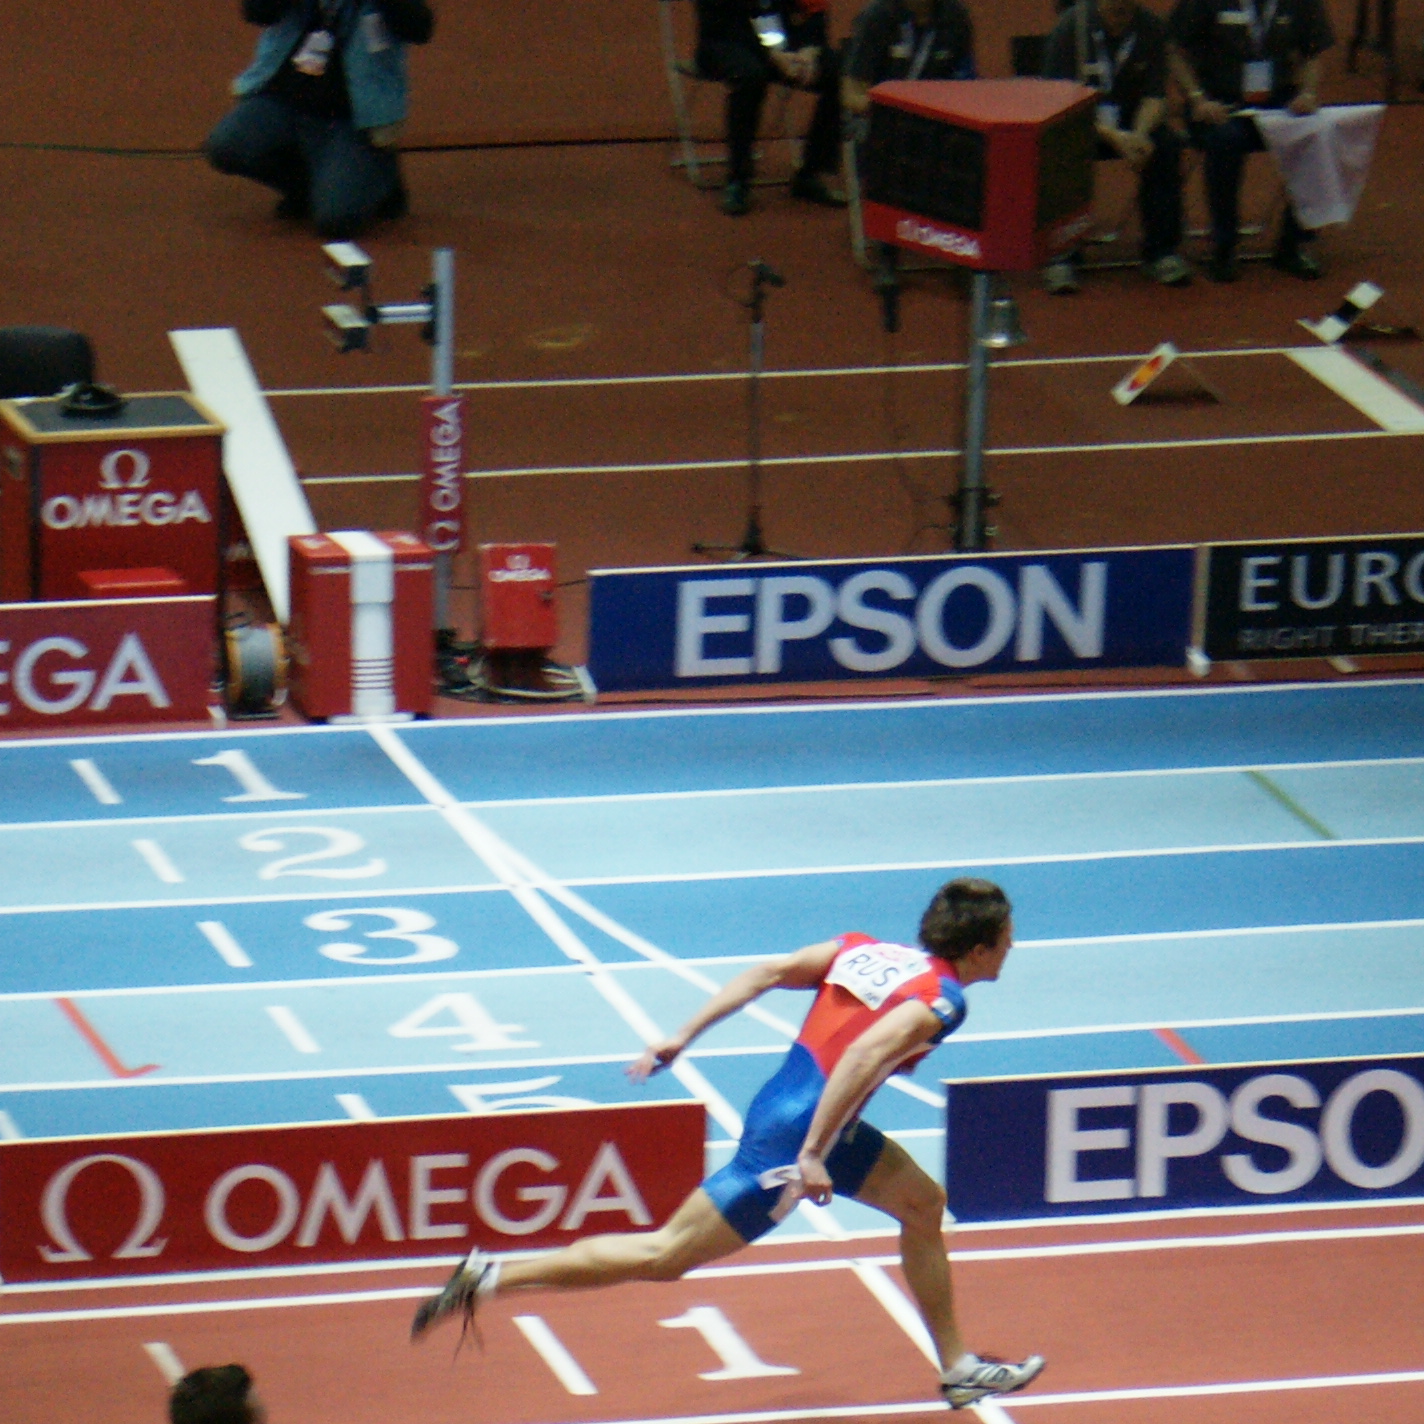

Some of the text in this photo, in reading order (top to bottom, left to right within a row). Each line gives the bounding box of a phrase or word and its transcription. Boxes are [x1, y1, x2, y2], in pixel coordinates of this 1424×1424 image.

[429, 401, 463, 511] OMEGA
[41, 490, 212, 530] OMEGA
[675, 561, 1108, 677] EPSON
[191, 749, 310, 802] 1
[238, 825, 388, 881] 2
[303, 906, 460, 966] 3
[843, 953, 900, 988] RUS
[386, 992, 542, 1052] 4
[205, 1141, 654, 1253] OMEGA
[657, 1305, 801, 1381] 1
